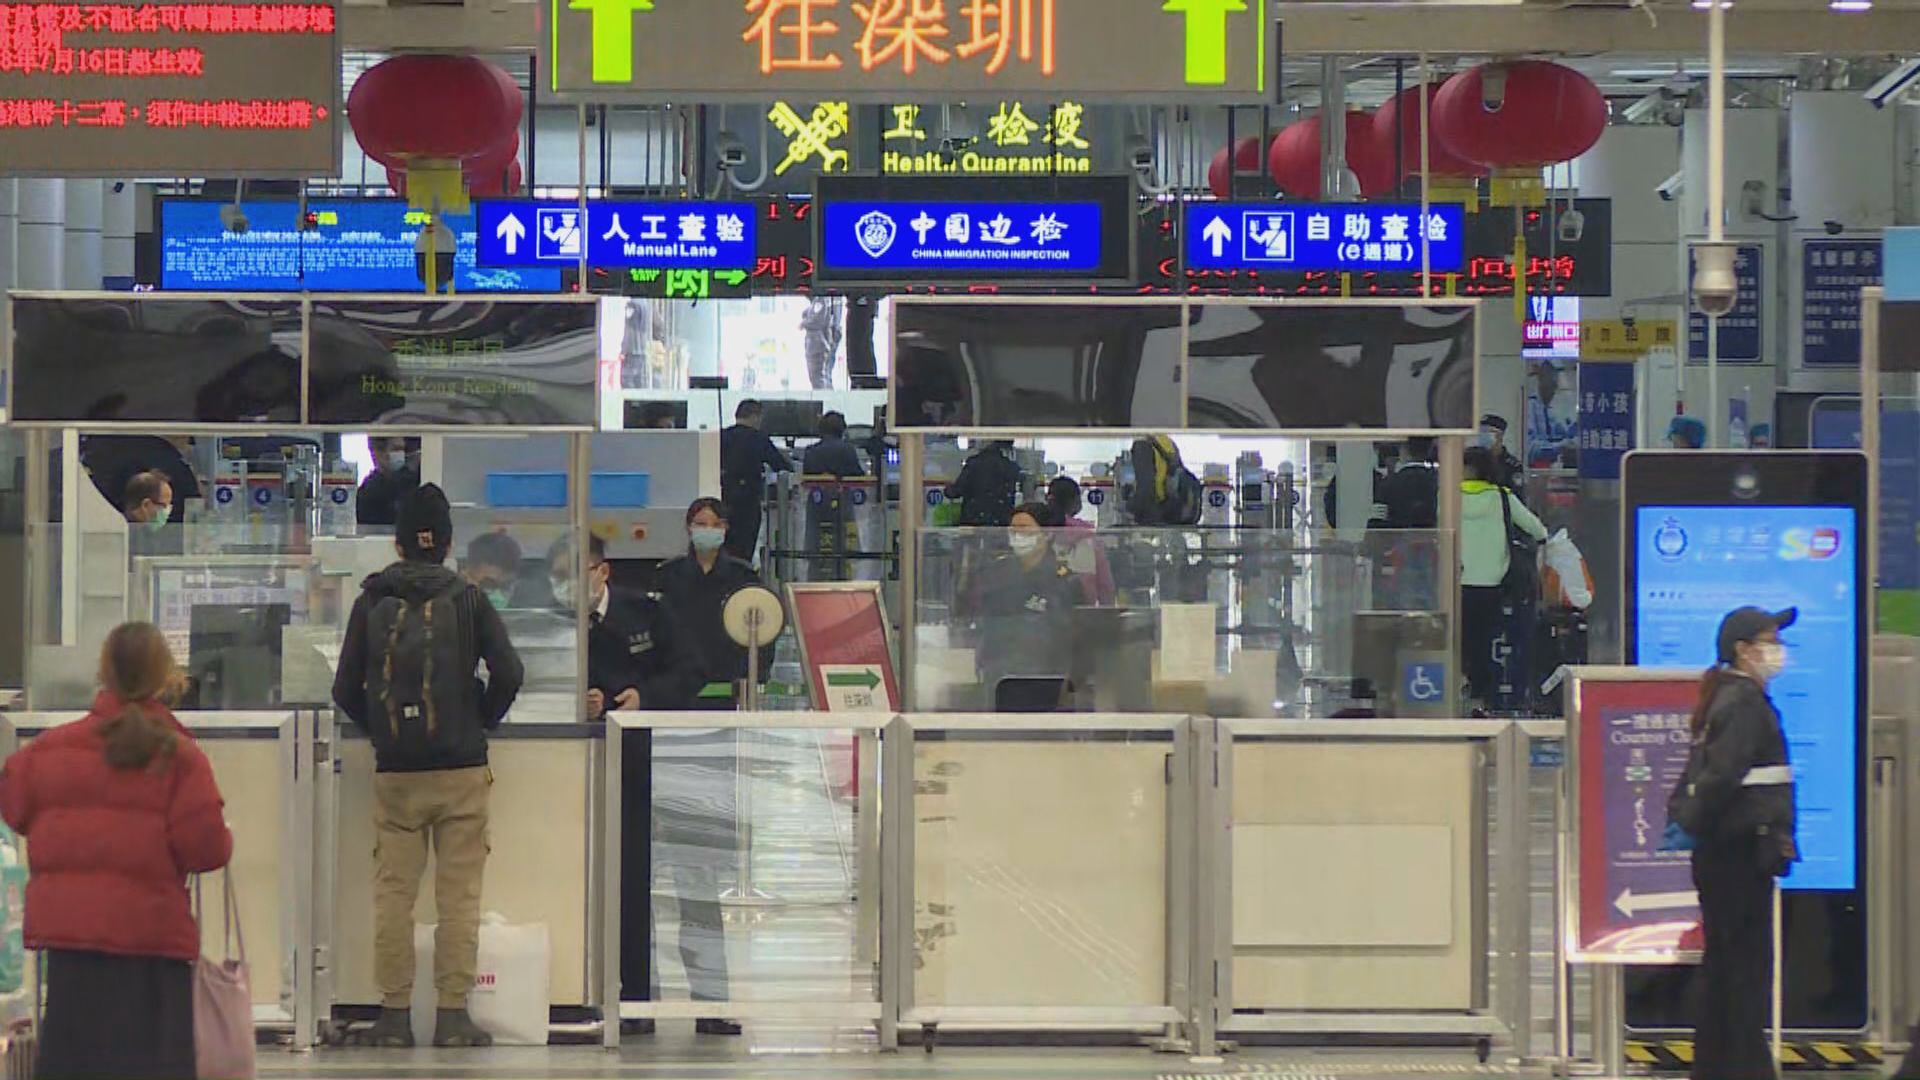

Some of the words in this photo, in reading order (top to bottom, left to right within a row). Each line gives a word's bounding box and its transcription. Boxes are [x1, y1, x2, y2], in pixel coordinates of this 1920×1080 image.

[742, 0, 1055, 75] 往深圳
[884, 101, 1089, 149] 卫检疫
[962, 151, 1090, 173] Quarantine
[602, 212, 744, 242] 人工查验
[910, 211, 1069, 246] 中国边检
[1307, 212, 1448, 242] 自助查验
[623, 242, 678, 257] Manual
[679, 243, 718, 257] Lane
[911, 249, 942, 260] CHINA
[943, 249, 1009, 260] IMMIGRATION
[1010, 249, 1070, 260] INSPECTION
[1337, 242, 1414, 263] (e通道)
[361, 376, 405, 397] Hong
[413, 376, 457, 397] Kong
[1611, 730, 1667, 745] Courtesy
